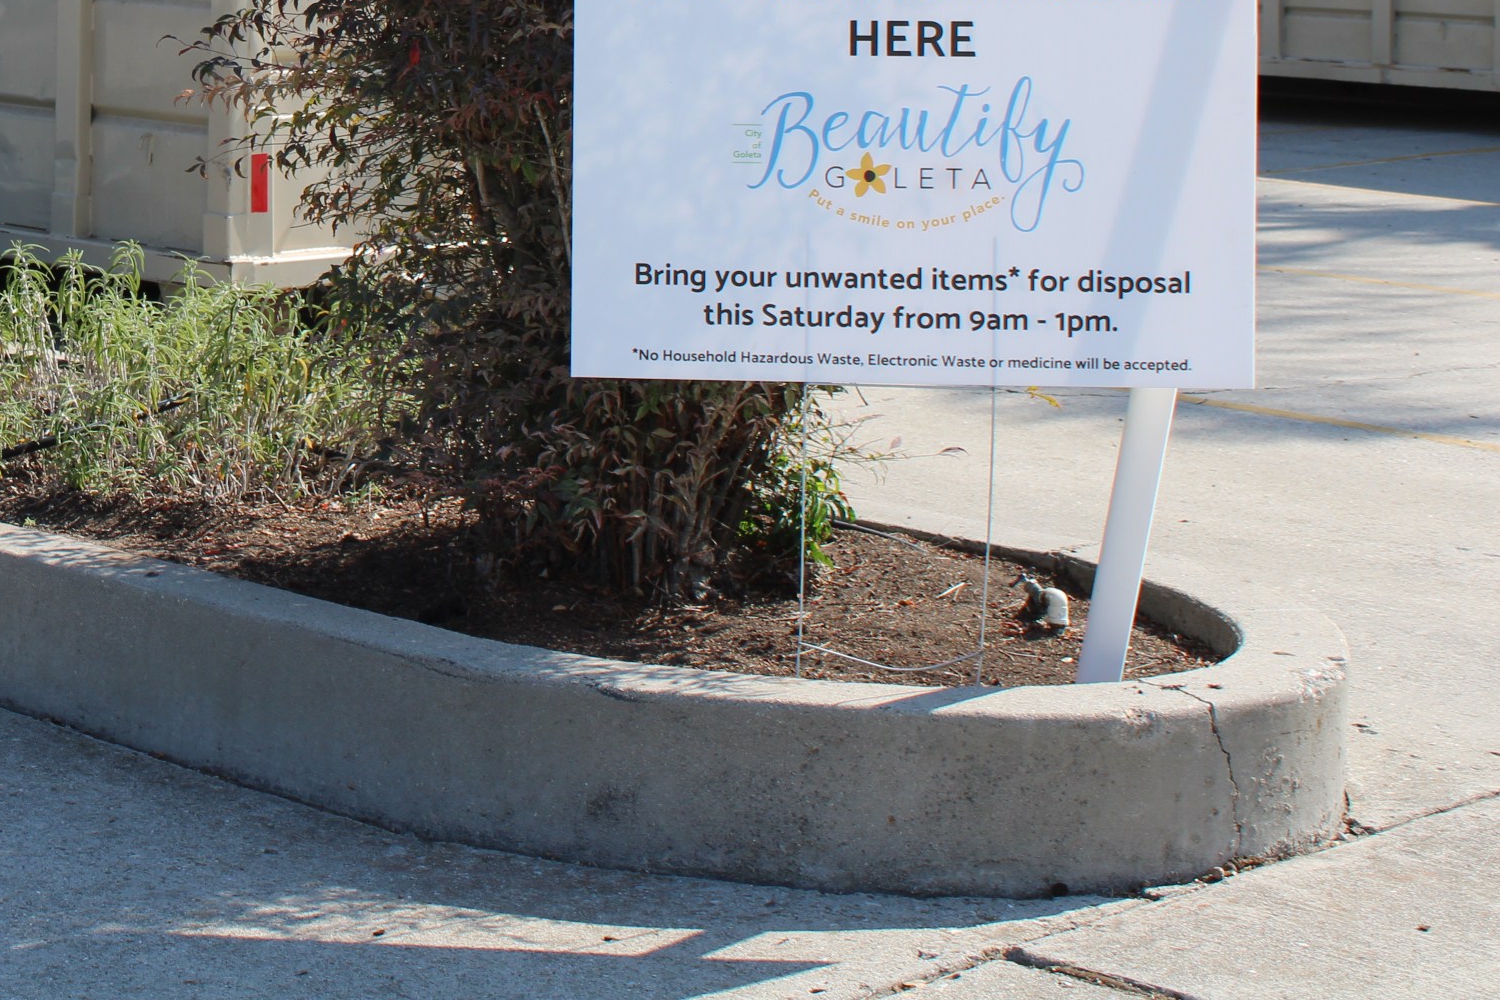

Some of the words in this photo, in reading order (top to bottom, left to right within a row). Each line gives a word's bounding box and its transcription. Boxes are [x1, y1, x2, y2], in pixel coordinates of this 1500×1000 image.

[849, 20, 977, 57] HERE
[744, 129, 762, 139] City
[752, 141, 762, 149] of
[732, 150, 762, 159] Goleta
[746, 76, 1085, 232] Beautify
[808, 188, 833, 210] Put
[836, 206, 845, 217] a
[850, 211, 890, 228] smile
[896, 219, 915, 229] on
[922, 214, 956, 231] your
[634, 262, 706, 293] Bring
[714, 270, 777, 293] your
[785, 267, 922, 290] unwanted
[1027, 268, 1070, 292] for
[1077, 269, 1191, 299] disposal
[704, 302, 754, 326] this
[762, 303, 885, 334] Saturday
[893, 306, 961, 329] from
[969, 311, 1028, 332] 9am
[1054, 312, 1118, 338] 1pm.
[663, 349, 736, 364] Household
[740, 350, 814, 365] Hazardous
[817, 352, 864, 367] Waste,
[867, 353, 938, 367] Electronic
[942, 355, 986, 369] Waste
[988, 359, 1004, 369] or
[1007, 356, 1072, 370] medicine
[1075, 357, 1099, 370] will
[1102, 357, 1120, 371] be
[1123, 358, 1193, 373] accepted.
